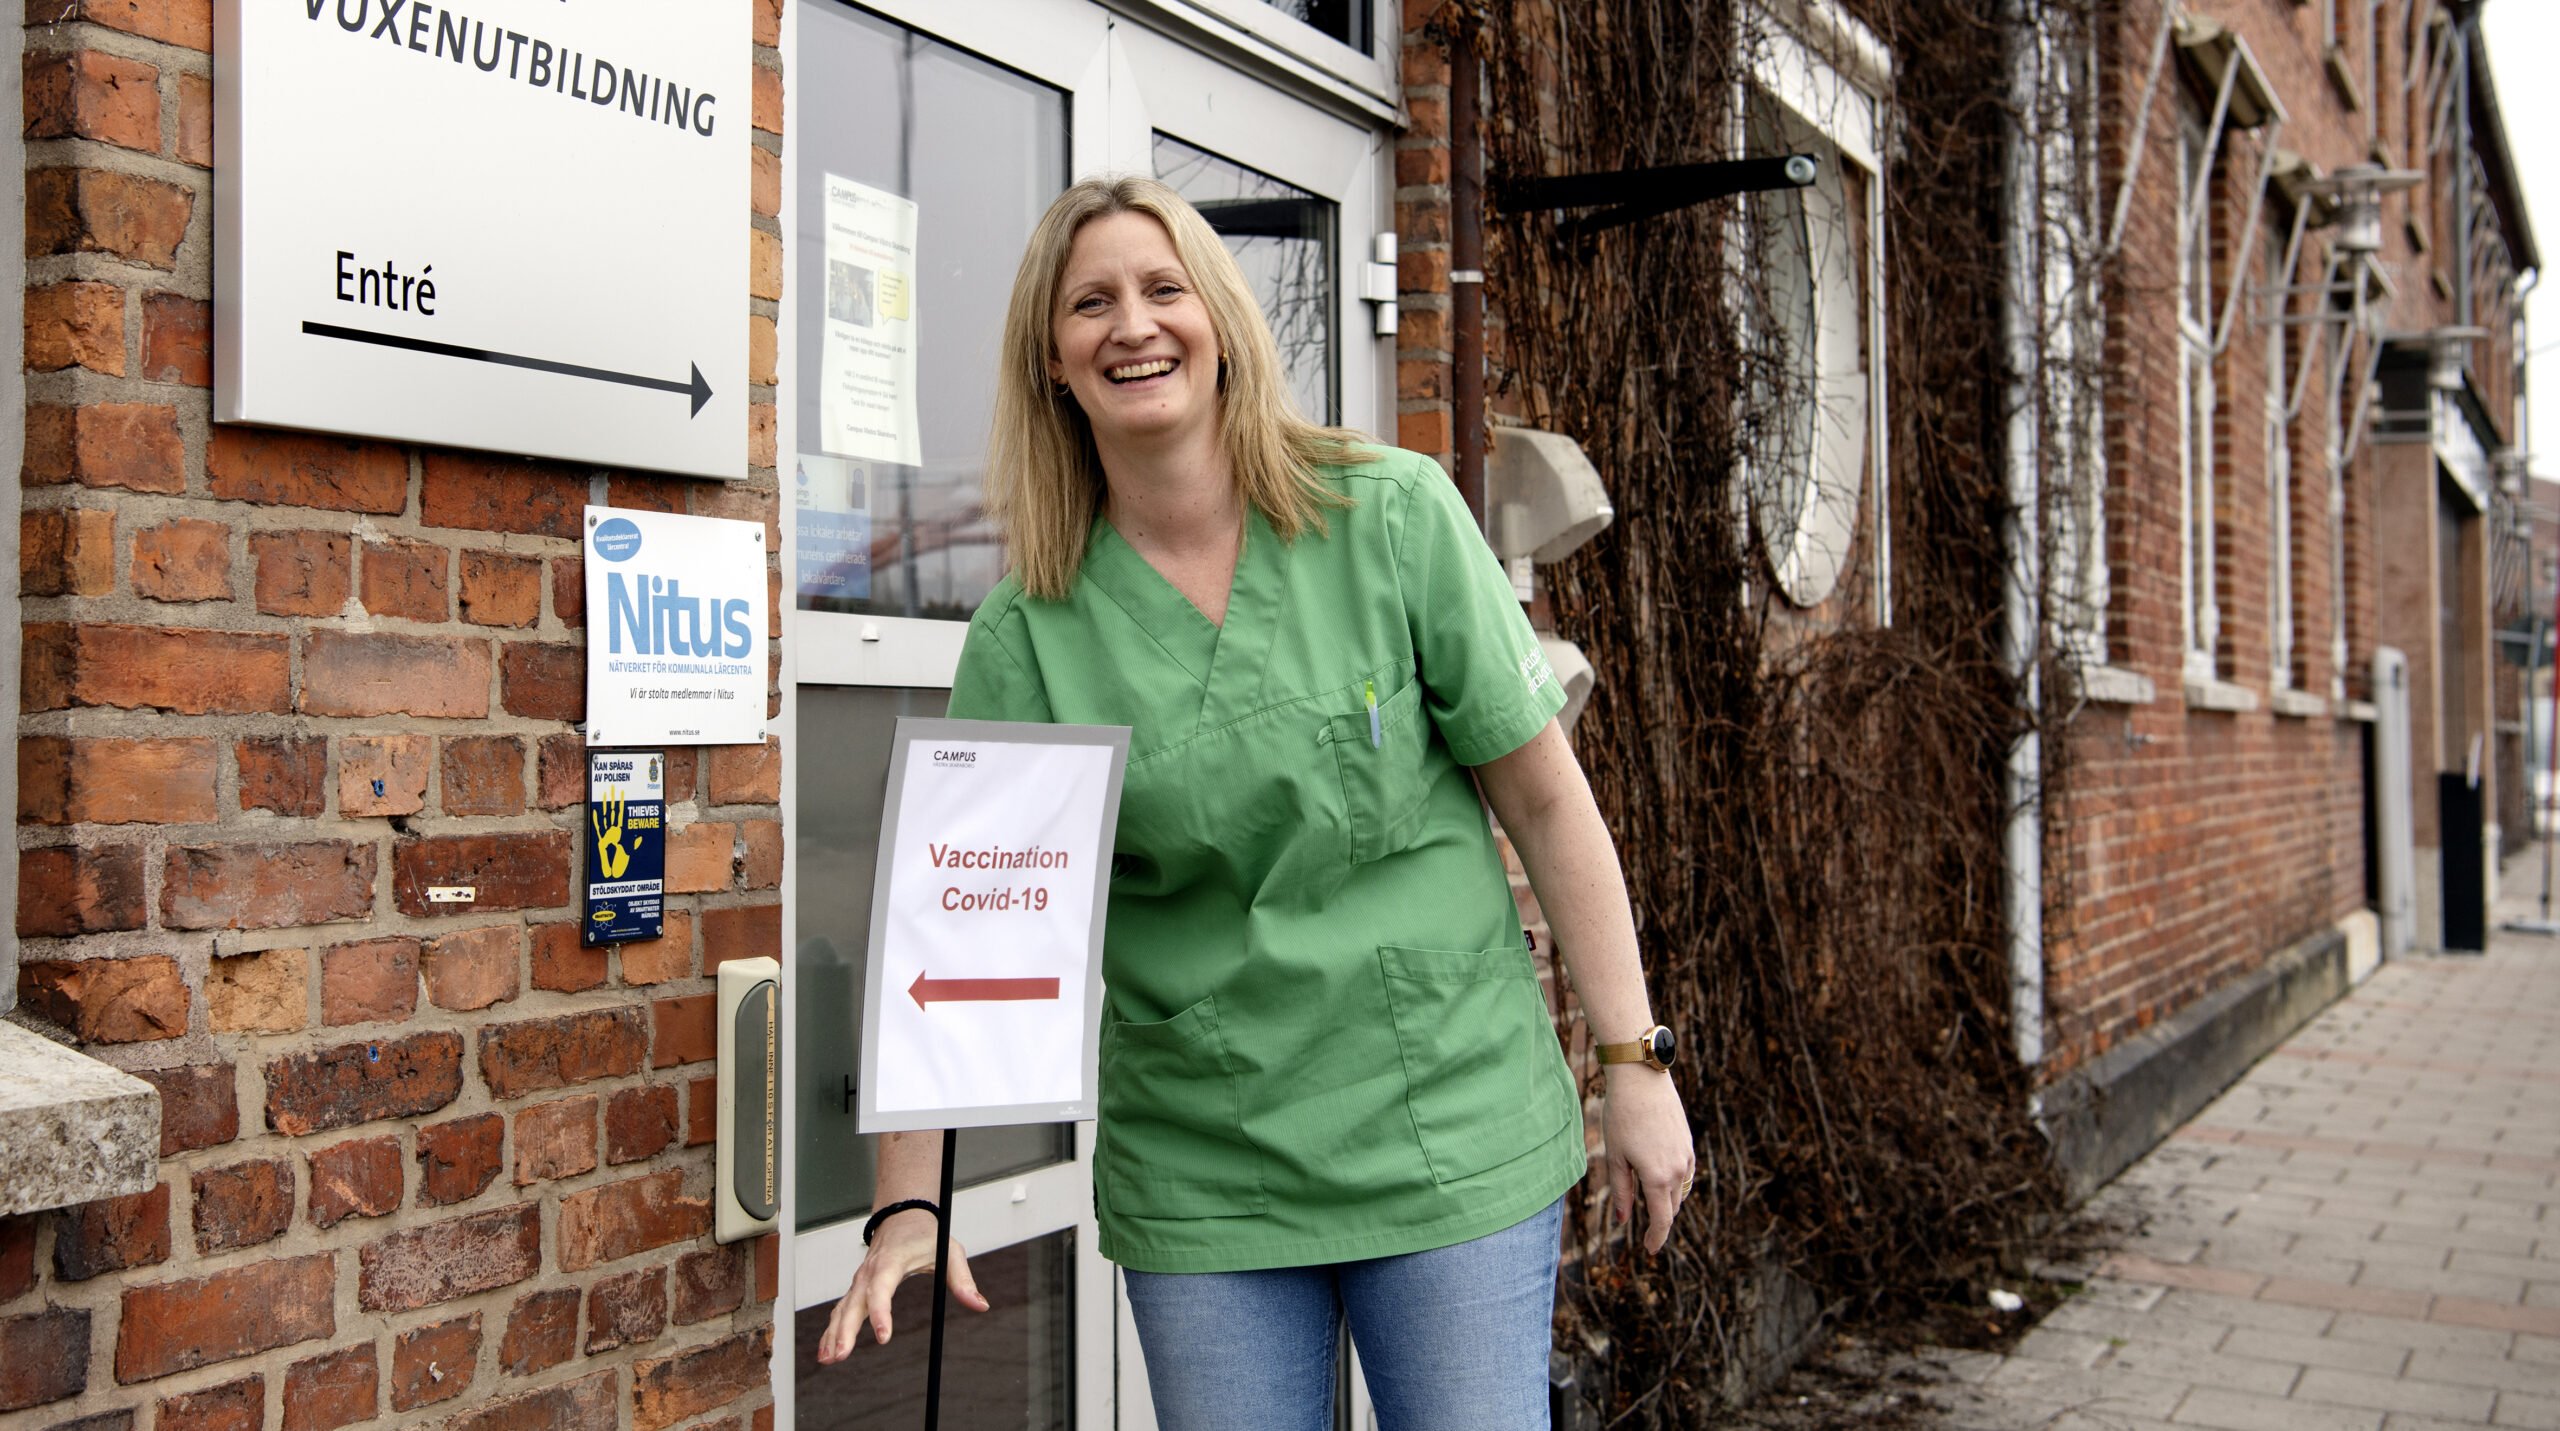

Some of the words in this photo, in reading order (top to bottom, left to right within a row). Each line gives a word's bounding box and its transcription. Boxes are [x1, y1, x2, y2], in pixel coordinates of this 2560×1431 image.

[337, 250, 436, 316] Entré
[810, 523, 835, 539] lokaler
[607, 572, 752, 660] Nitus
[609, 660, 651, 673] NÄTVERKET
[653, 660, 667, 674] FÖR
[668, 663, 714, 675] KOMMUNALA
[714, 662, 752, 676] LÄRCENTRA
[630, 687, 638, 699] Vi
[639, 688, 646, 699] är
[649, 687, 669, 699] stolta
[671, 688, 713, 700] medlemmar
[717, 688, 735, 700] Nitus
[669, 728, 701, 736] www.nitus.se
[934, 750, 976, 762] CAMPUS
[595, 762, 607, 771] KAN
[609, 759, 633, 770] SPÅRAS
[594, 774, 602, 782] AV
[604, 773, 630, 782] POLISEN
[628, 805, 660, 817] THIEVES
[628, 817, 660, 829] BEWARE
[929, 843, 1068, 869] Vaccination
[592, 885, 636, 896] STÖLDSKYDDAT
[637, 881, 660, 892] OMRÅDE
[942, 887, 1048, 911] Covid-19
